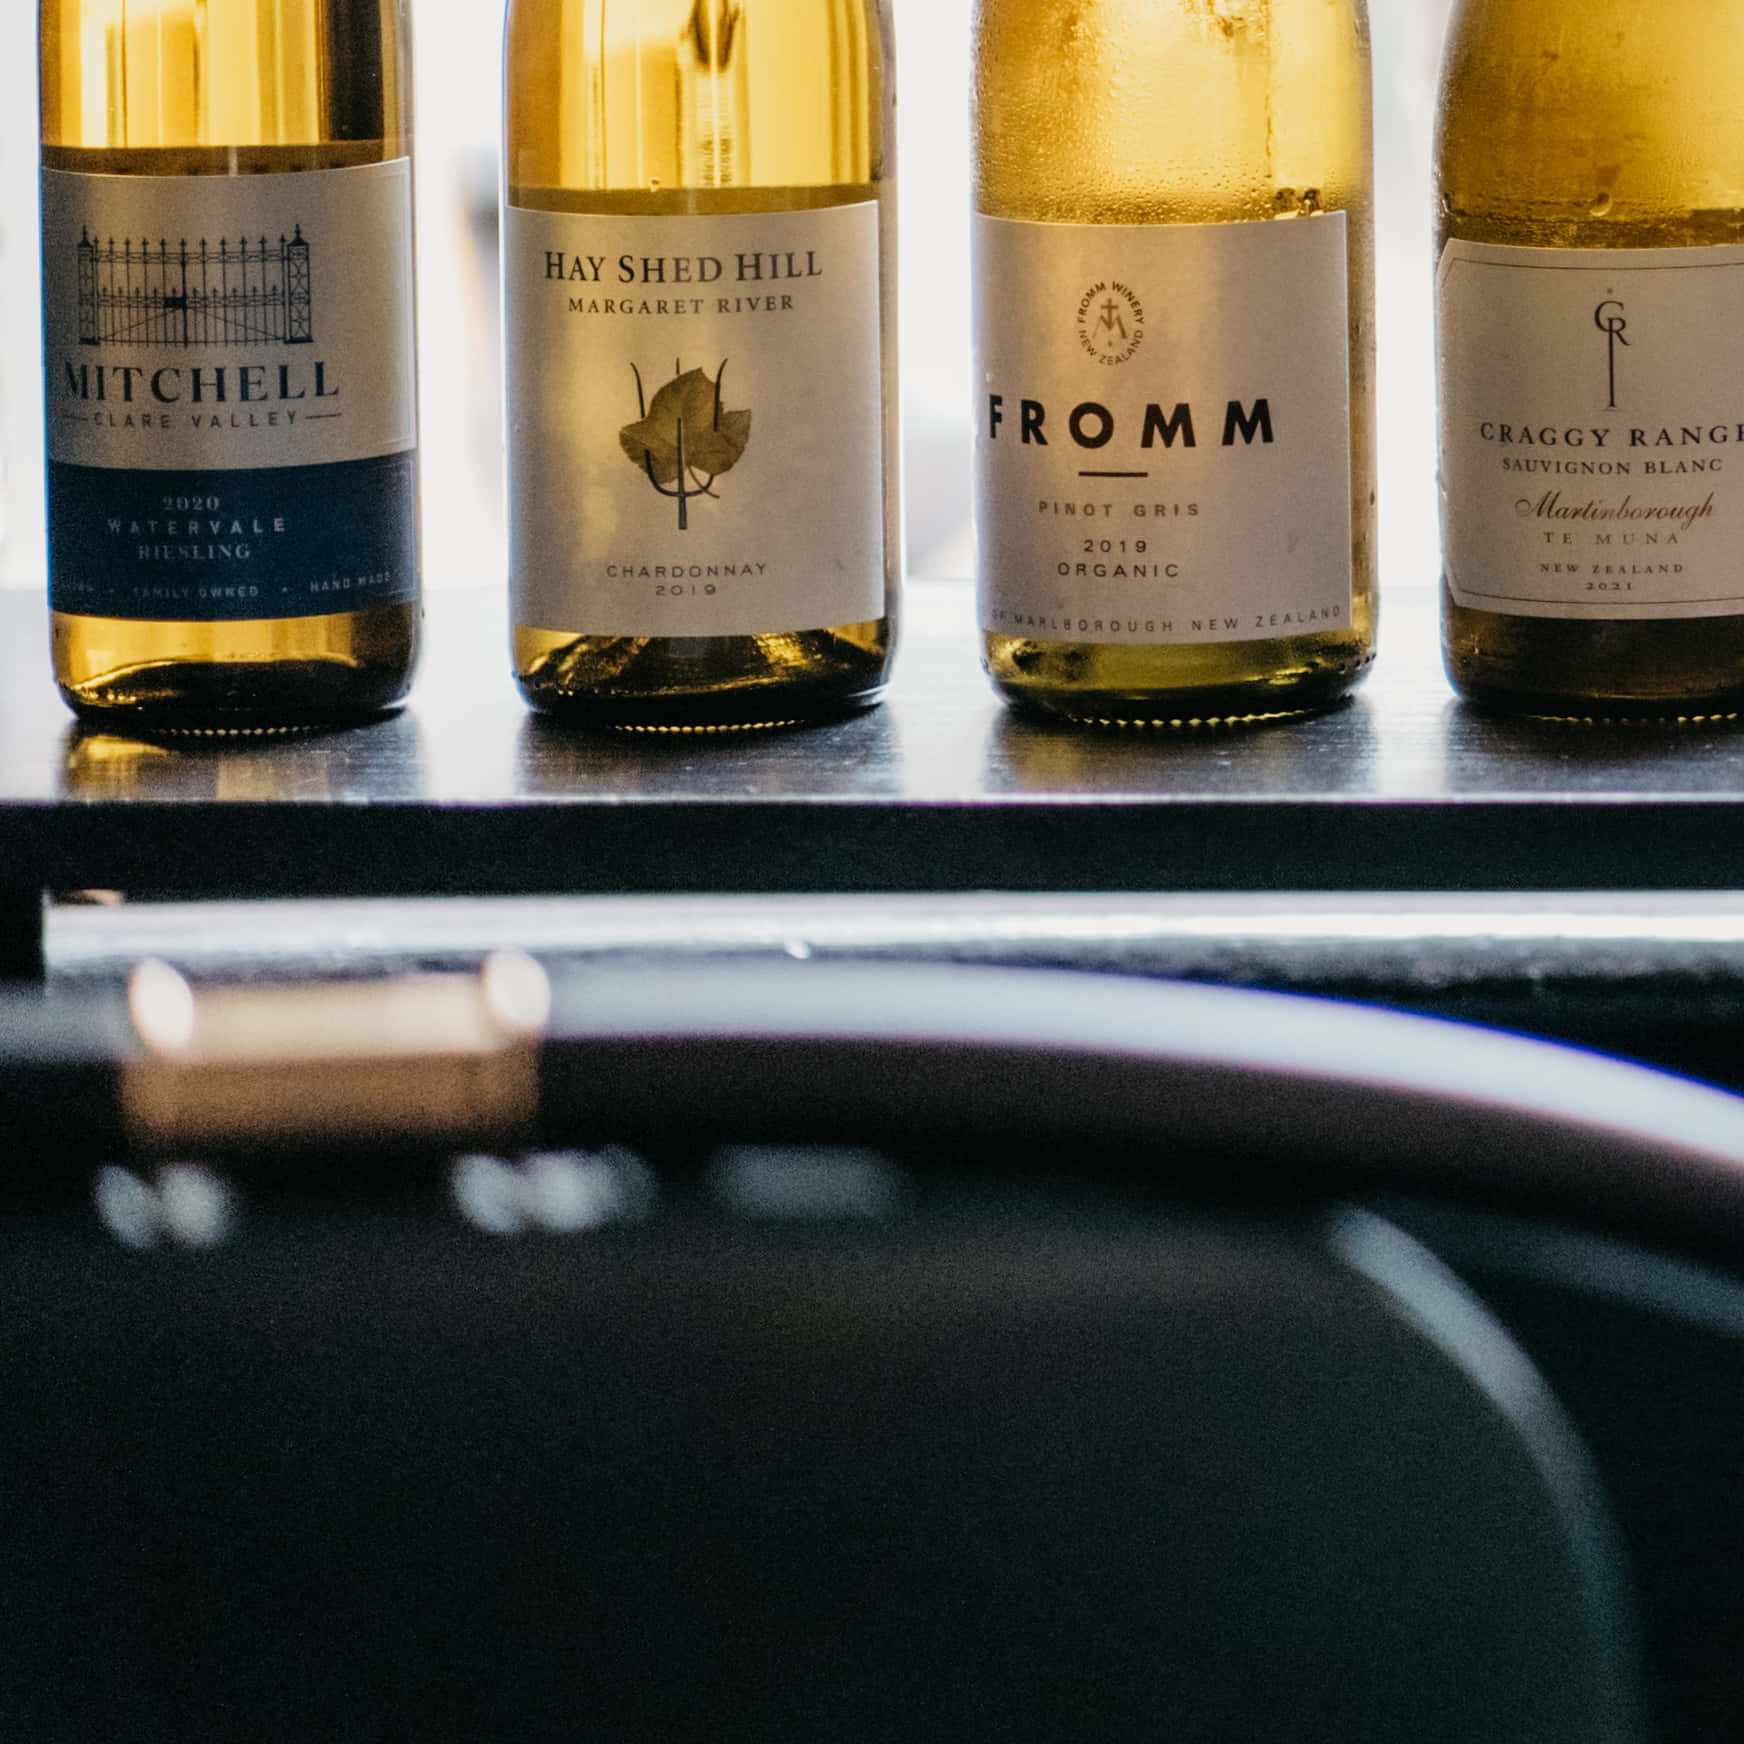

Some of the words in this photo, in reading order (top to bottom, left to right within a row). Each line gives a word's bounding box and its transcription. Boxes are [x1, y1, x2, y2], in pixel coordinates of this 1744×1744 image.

[544, 251, 606, 283] HAY
[618, 255, 724, 284] SHED
[735, 250, 823, 281] HILL
[568, 297, 704, 314] MARGARET
[718, 295, 795, 313] RIVER
[1076, 281, 1107, 324] FROMM
[1112, 280, 1145, 325] WINERY
[64, 361, 339, 404] MITCHELL
[93, 410, 171, 428] CLARE
[192, 409, 298, 429] VALLEY
[988, 394, 1275, 450] FROMM
[1480, 422, 1611, 447] CRAGGY
[1502, 457, 1631, 475] SAUVIGNON
[1644, 458, 1723, 474] BLANC
[161, 495, 221, 511] 2020
[1038, 500, 1113, 518] PINOT
[1134, 502, 1200, 519] GRIS
[1514, 490, 1716, 529] Martinborough
[107, 517, 287, 536] WATERVALE
[1083, 540, 1148, 554] 2019
[1543, 532, 1574, 545] TE
[1595, 532, 1679, 545] MUNA
[137, 543, 252, 560] RIESLING
[606, 561, 768, 579] CHARDONNAY
[1057, 562, 1180, 578] ORGANIC
[1539, 563, 1581, 574] NEW
[1592, 563, 1685, 574] ZEALAND
[655, 584, 718, 597] 2019
[1585, 582, 1633, 591] 2021
[1014, 614, 1173, 633] MARLBOROUGH
[1192, 616, 1239, 632] NEW
[1255, 605, 1341, 627] ZEALAND
